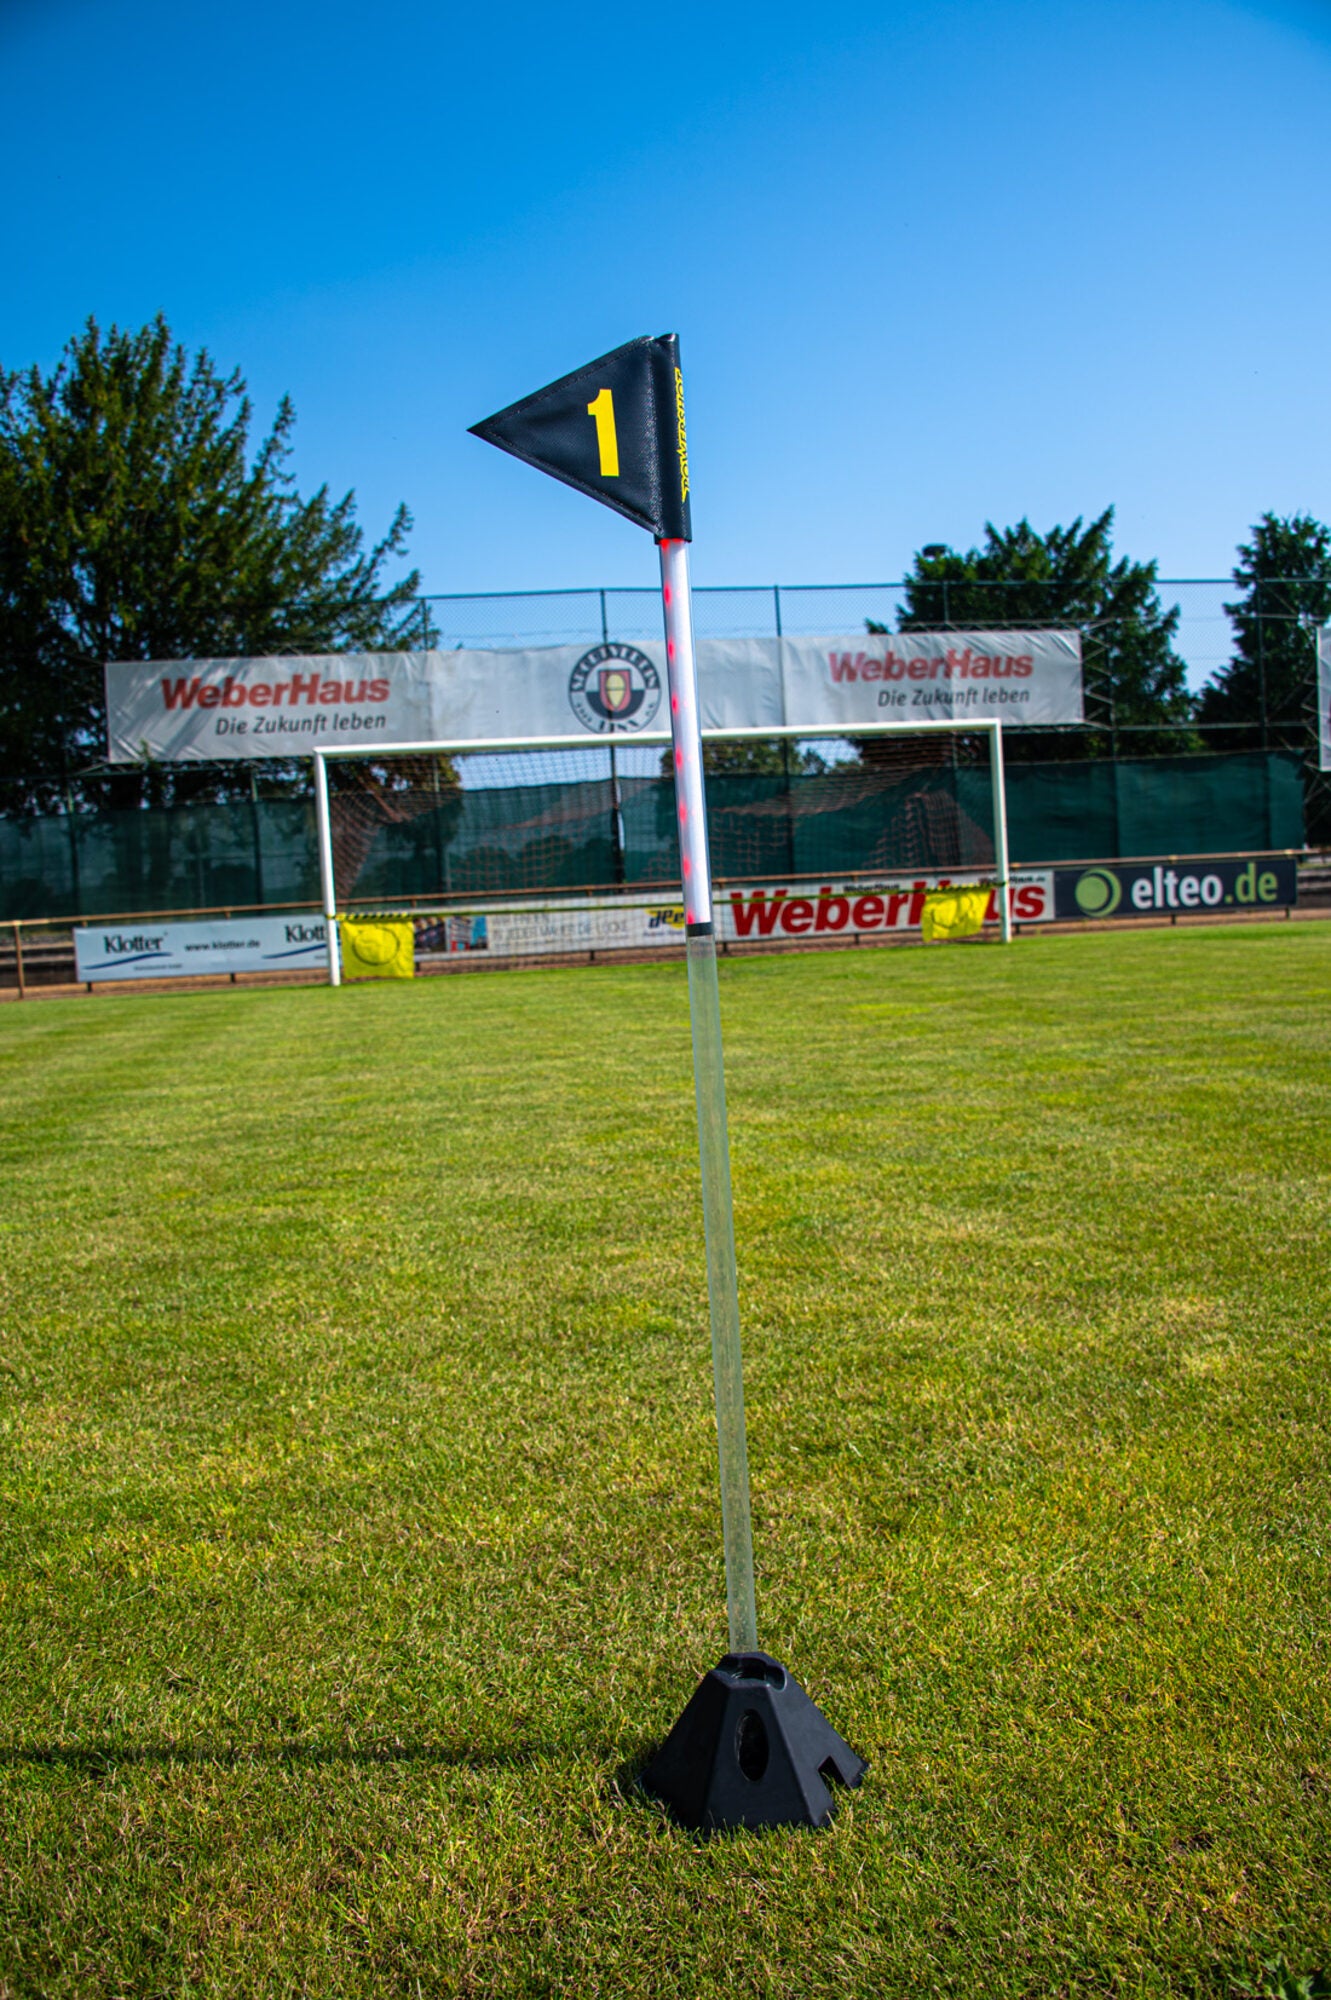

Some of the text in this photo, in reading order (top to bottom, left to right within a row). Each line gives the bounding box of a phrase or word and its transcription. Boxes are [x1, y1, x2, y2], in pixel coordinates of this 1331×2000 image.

[587, 388, 619, 477] 1
[674, 367, 689, 503] POWERSHOT
[829, 648, 1034, 683] WeberHaus
[161, 673, 391, 710] WeberHaus
[878, 686, 1030, 707] Die Zukunft leben
[215, 713, 386, 735] Die Zukunft leben
[1131, 862, 1278, 909] elteo.de
[729, 879, 1046, 938] WeberHus
[103, 935, 163, 954] Klotter
[284, 924, 325, 943] Klott
